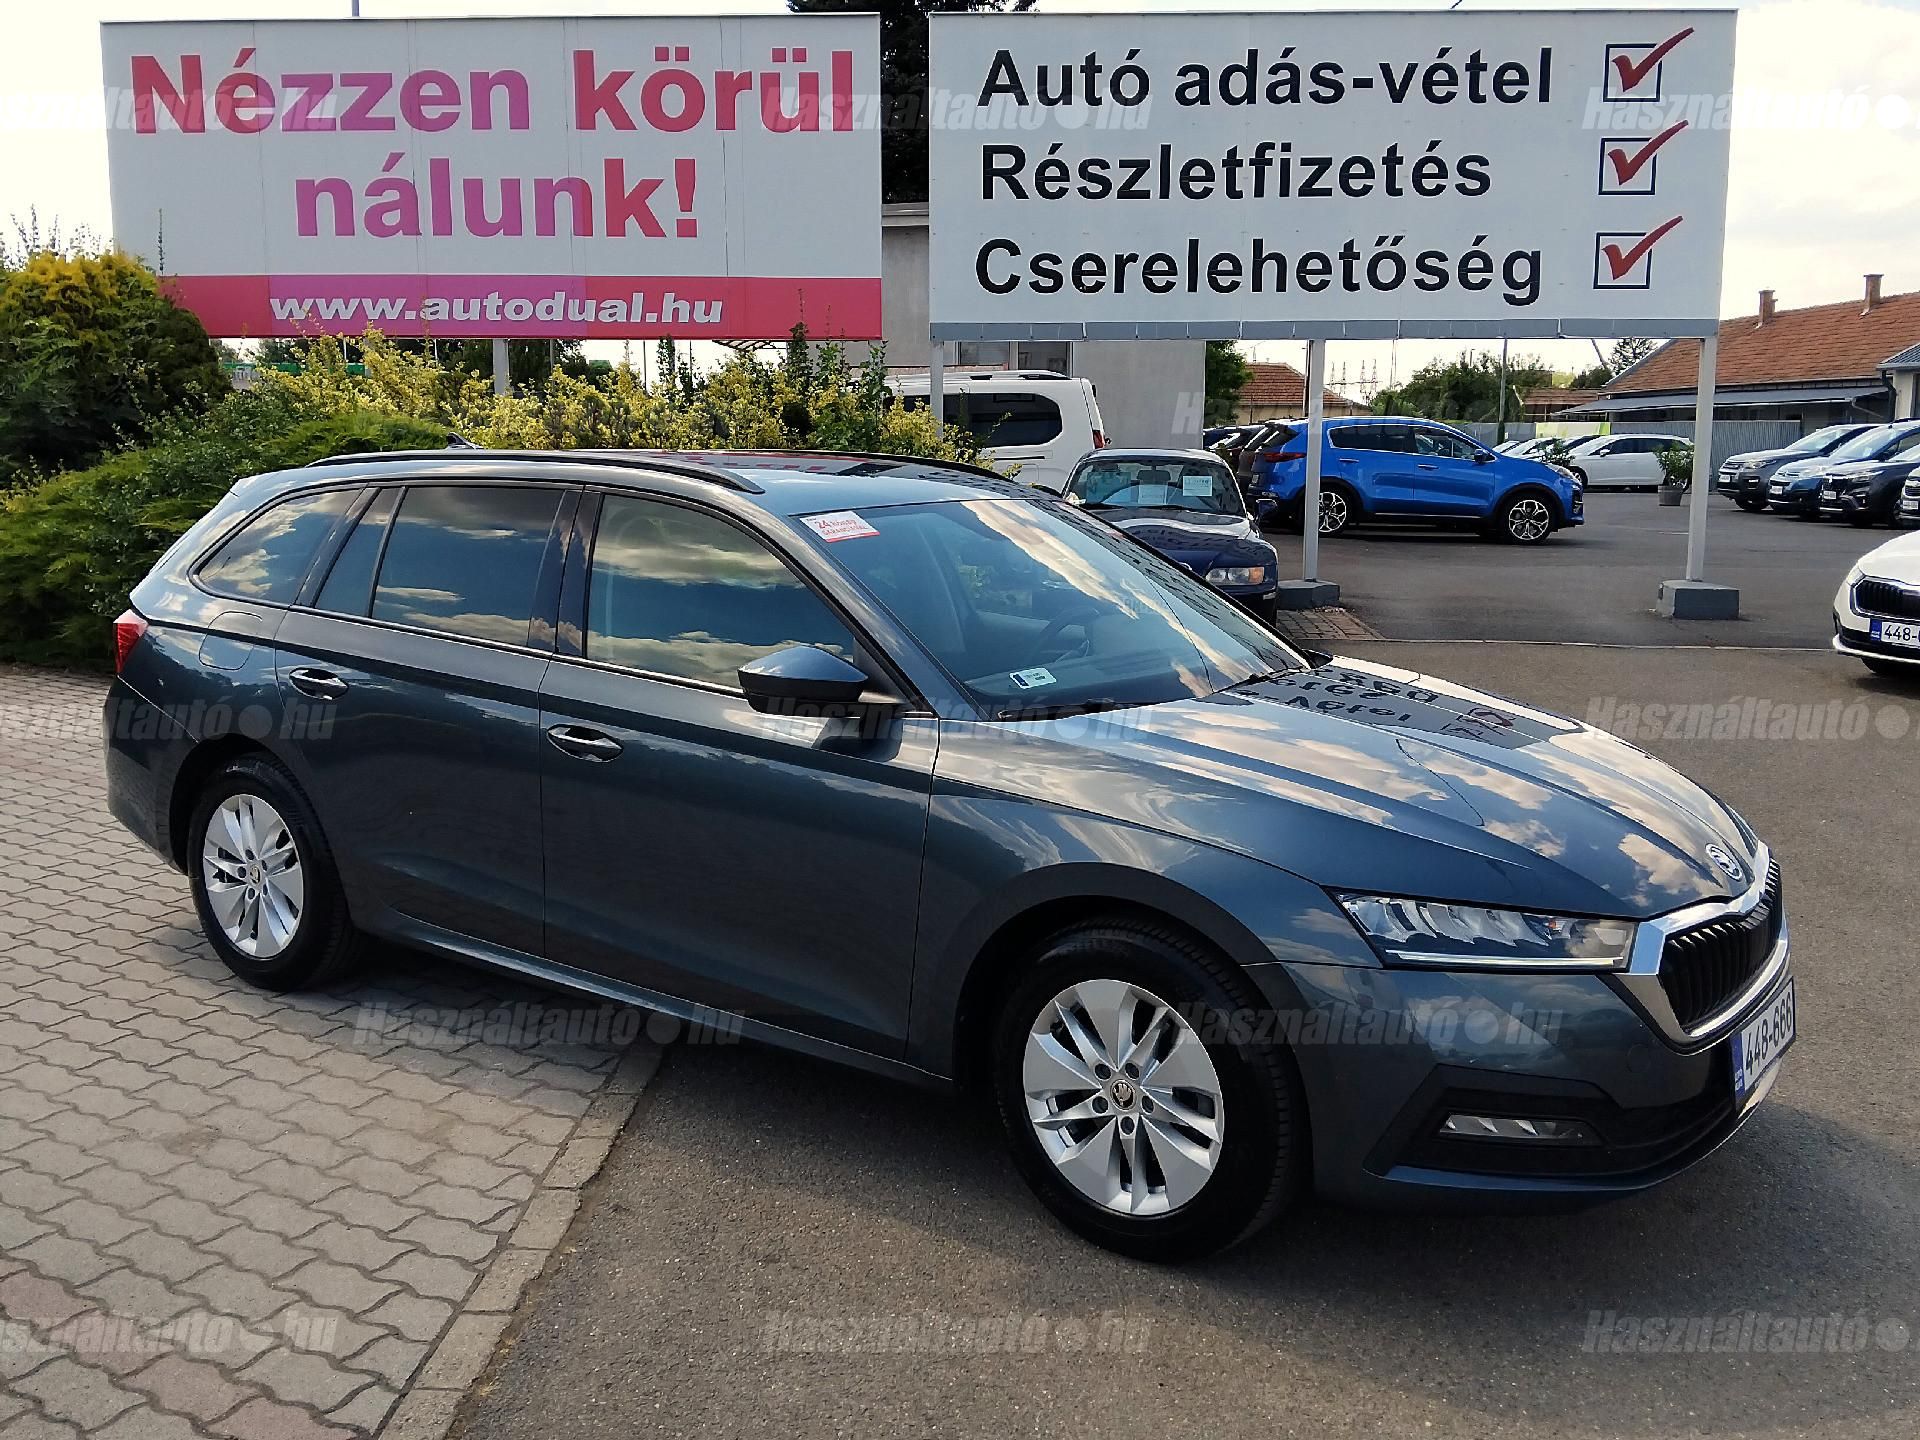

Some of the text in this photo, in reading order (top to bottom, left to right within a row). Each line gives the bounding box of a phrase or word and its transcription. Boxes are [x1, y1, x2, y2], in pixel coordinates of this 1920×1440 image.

[132, 47, 853, 133] Nézzen körül
[977, 47, 1551, 106] Autó adás-vétel
[297, 154, 697, 237] nálunk!
[983, 140, 1490, 199] Részletfizetés
[976, 235, 1540, 306] Cserelehetőség
[271, 292, 722, 322] www.autodual.hu
[1745, 991, 1792, 1076] 448-666
